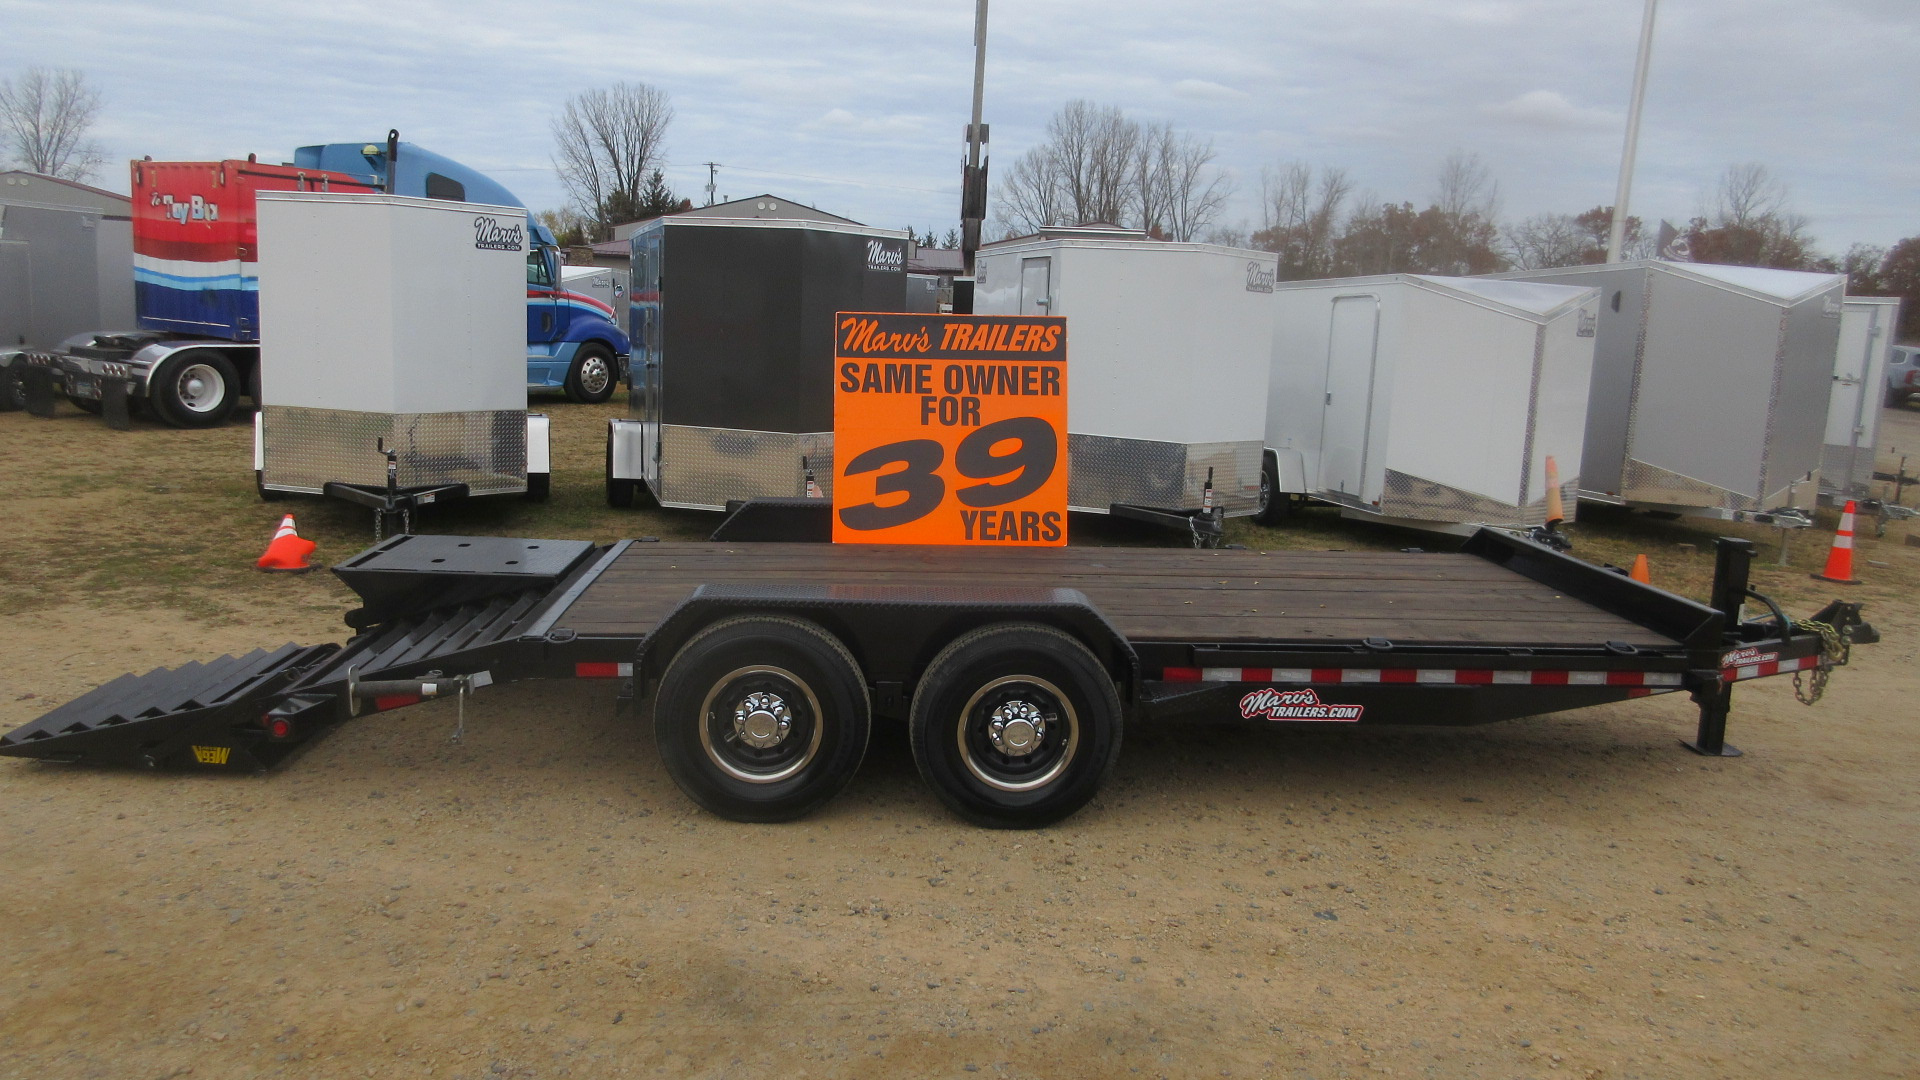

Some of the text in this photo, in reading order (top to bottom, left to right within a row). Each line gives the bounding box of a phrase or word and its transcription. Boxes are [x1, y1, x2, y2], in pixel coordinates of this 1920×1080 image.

[474, 216, 523, 244] Marv's
[867, 239, 904, 265] Marv's
[841, 317, 1062, 353] Marv's TRAILERS
[840, 362, 1060, 396] SAME OWNER
[920, 395, 981, 426] FOR
[838, 416, 1058, 531] 39
[960, 510, 1061, 542] YEARS
[1243, 690, 1315, 715] Marv's
[1270, 706, 1359, 718] TRAILERS.COM
